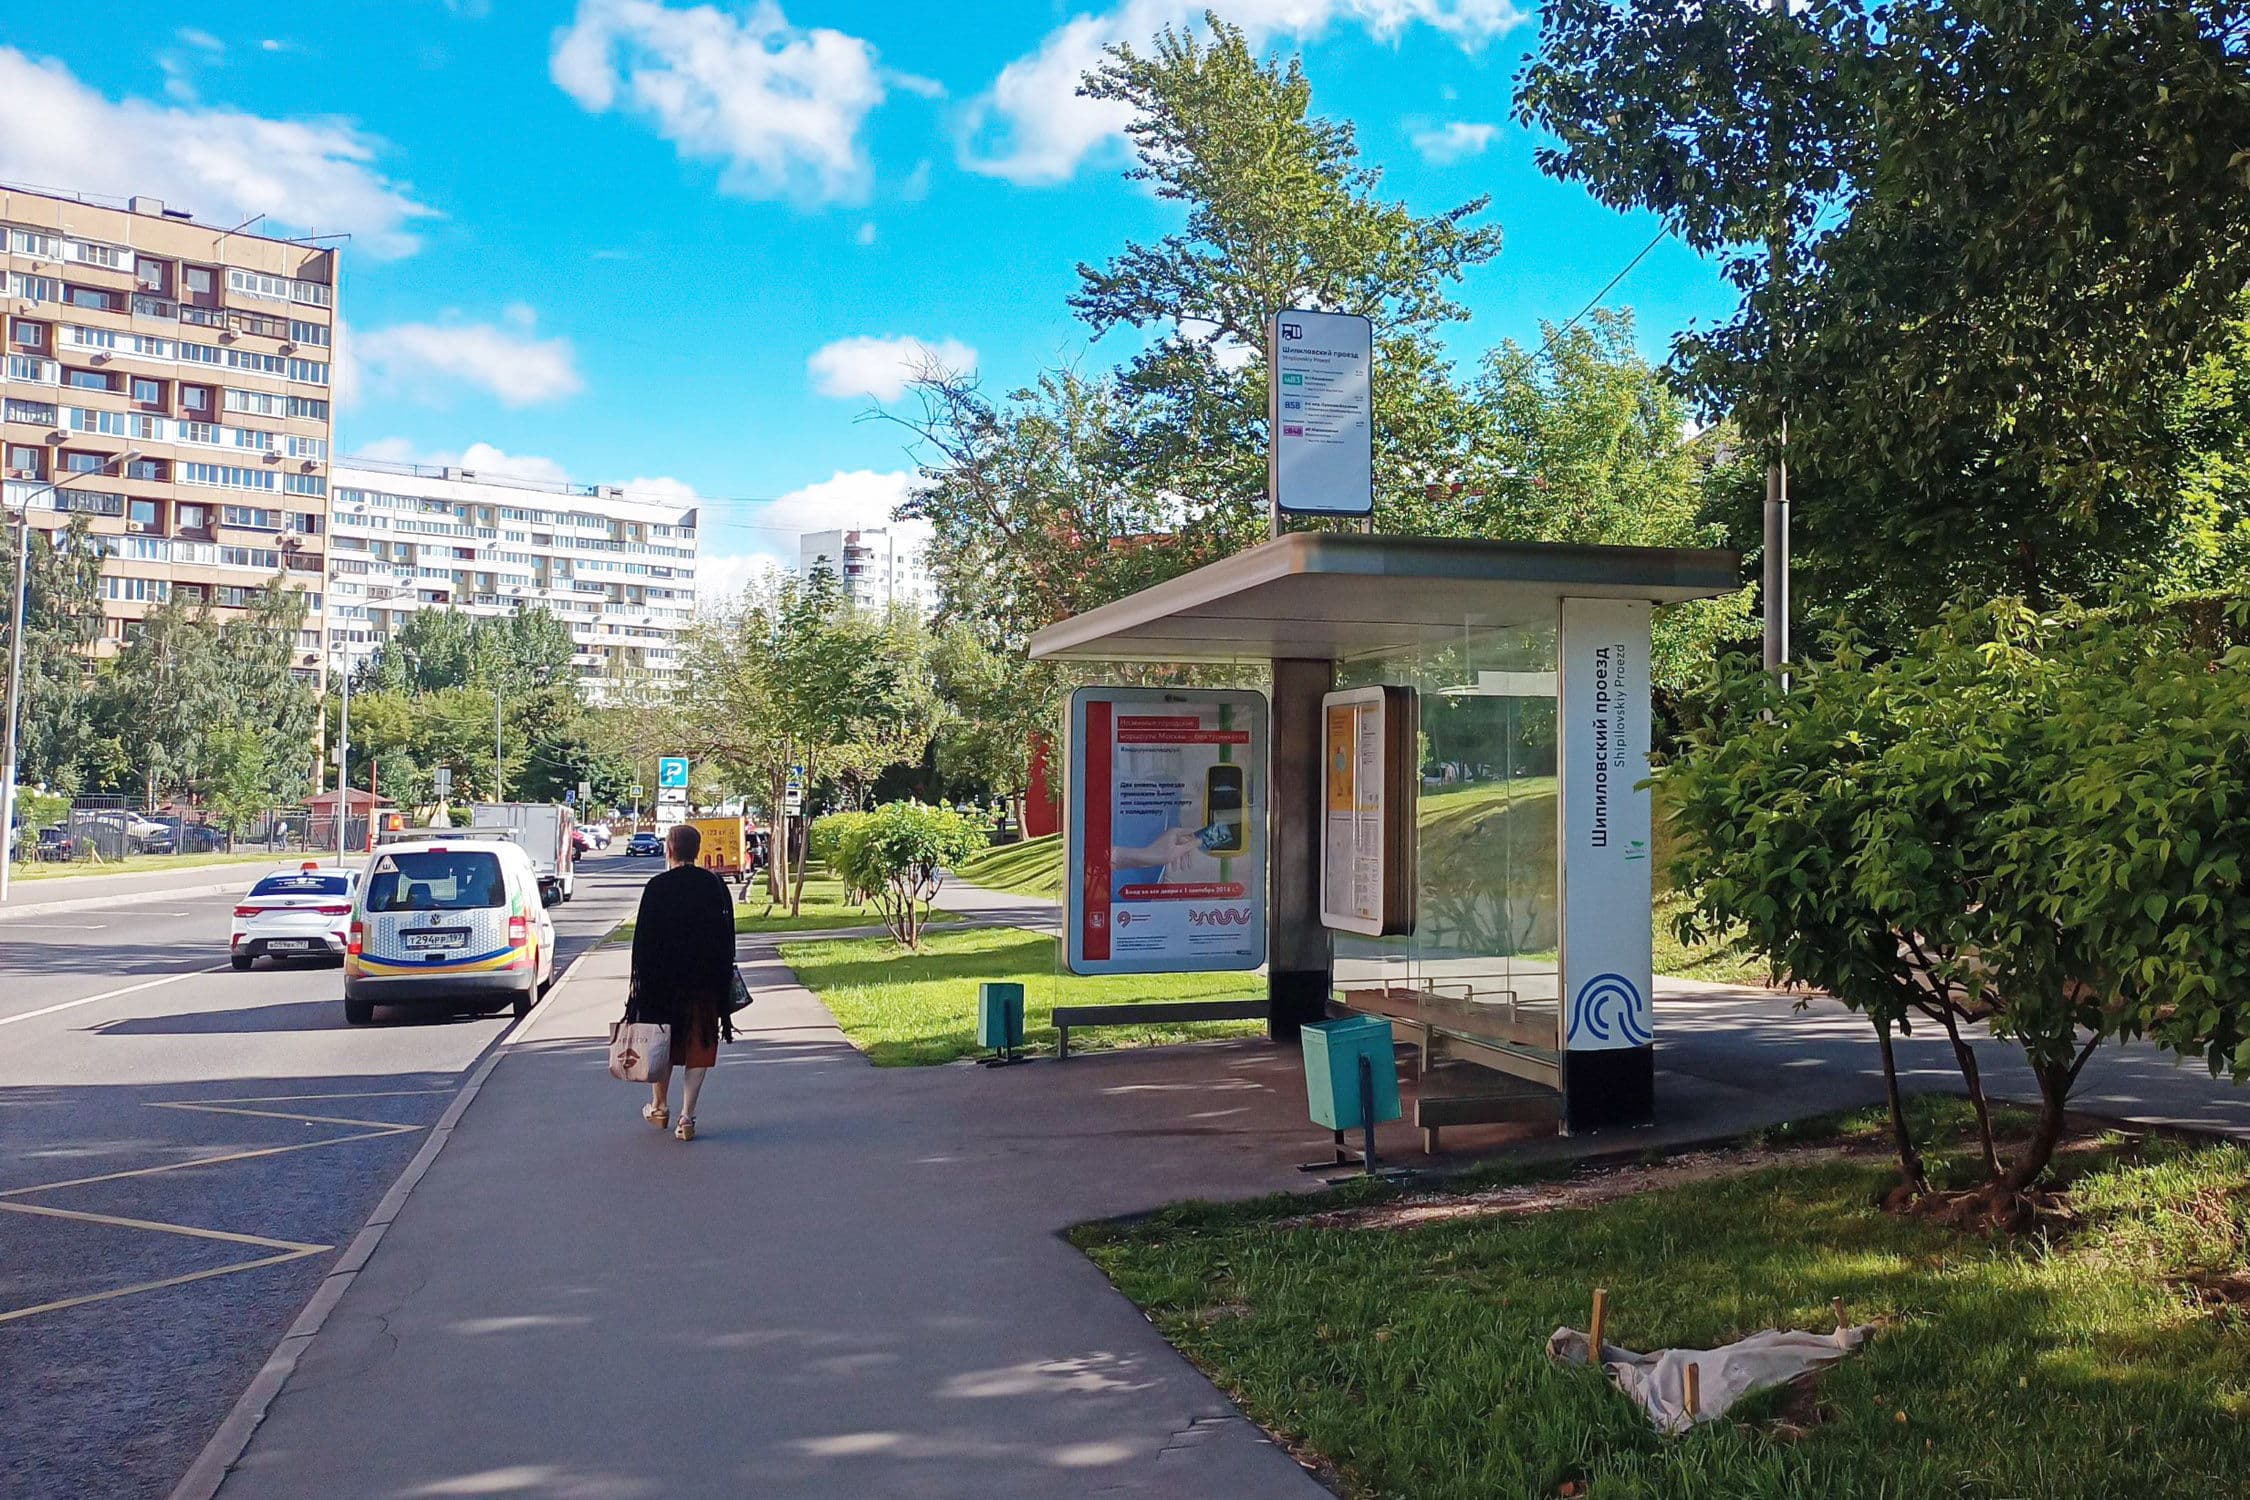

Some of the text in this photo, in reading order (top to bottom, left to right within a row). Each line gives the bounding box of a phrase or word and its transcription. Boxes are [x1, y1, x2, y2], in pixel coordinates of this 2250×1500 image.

[1591, 647, 1611, 847] Шипиловский проезд
[1614, 644, 1627, 768] Shipilovskiy Proezd
